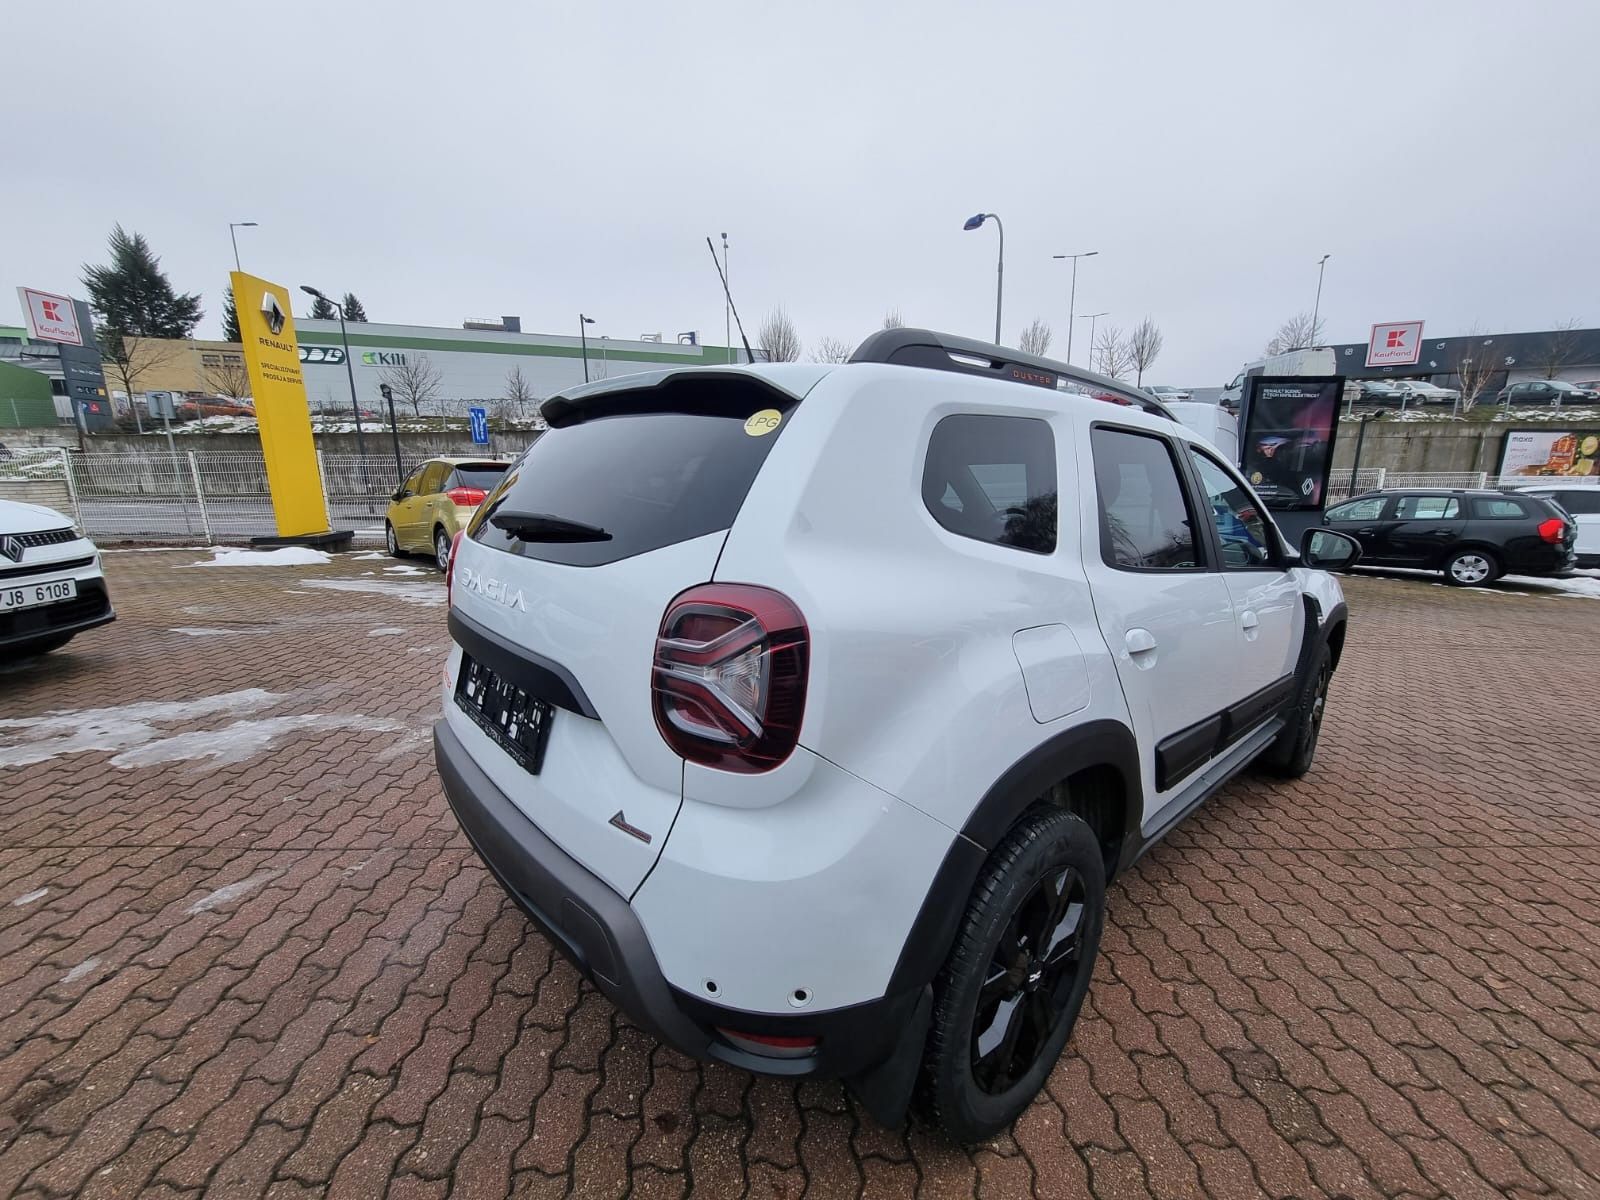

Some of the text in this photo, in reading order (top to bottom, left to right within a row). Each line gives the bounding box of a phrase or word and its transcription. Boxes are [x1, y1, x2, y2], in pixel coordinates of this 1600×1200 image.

[39, 324, 75, 337] Kaufland
[258, 337, 294, 353] RENAULT
[1375, 350, 1412, 358] Kaufland
[1013, 370, 1051, 384] DUSTER
[746, 417, 779, 428] LPG
[0, 583, 70, 607] J8 6108
[462, 567, 527, 613] DACIA
